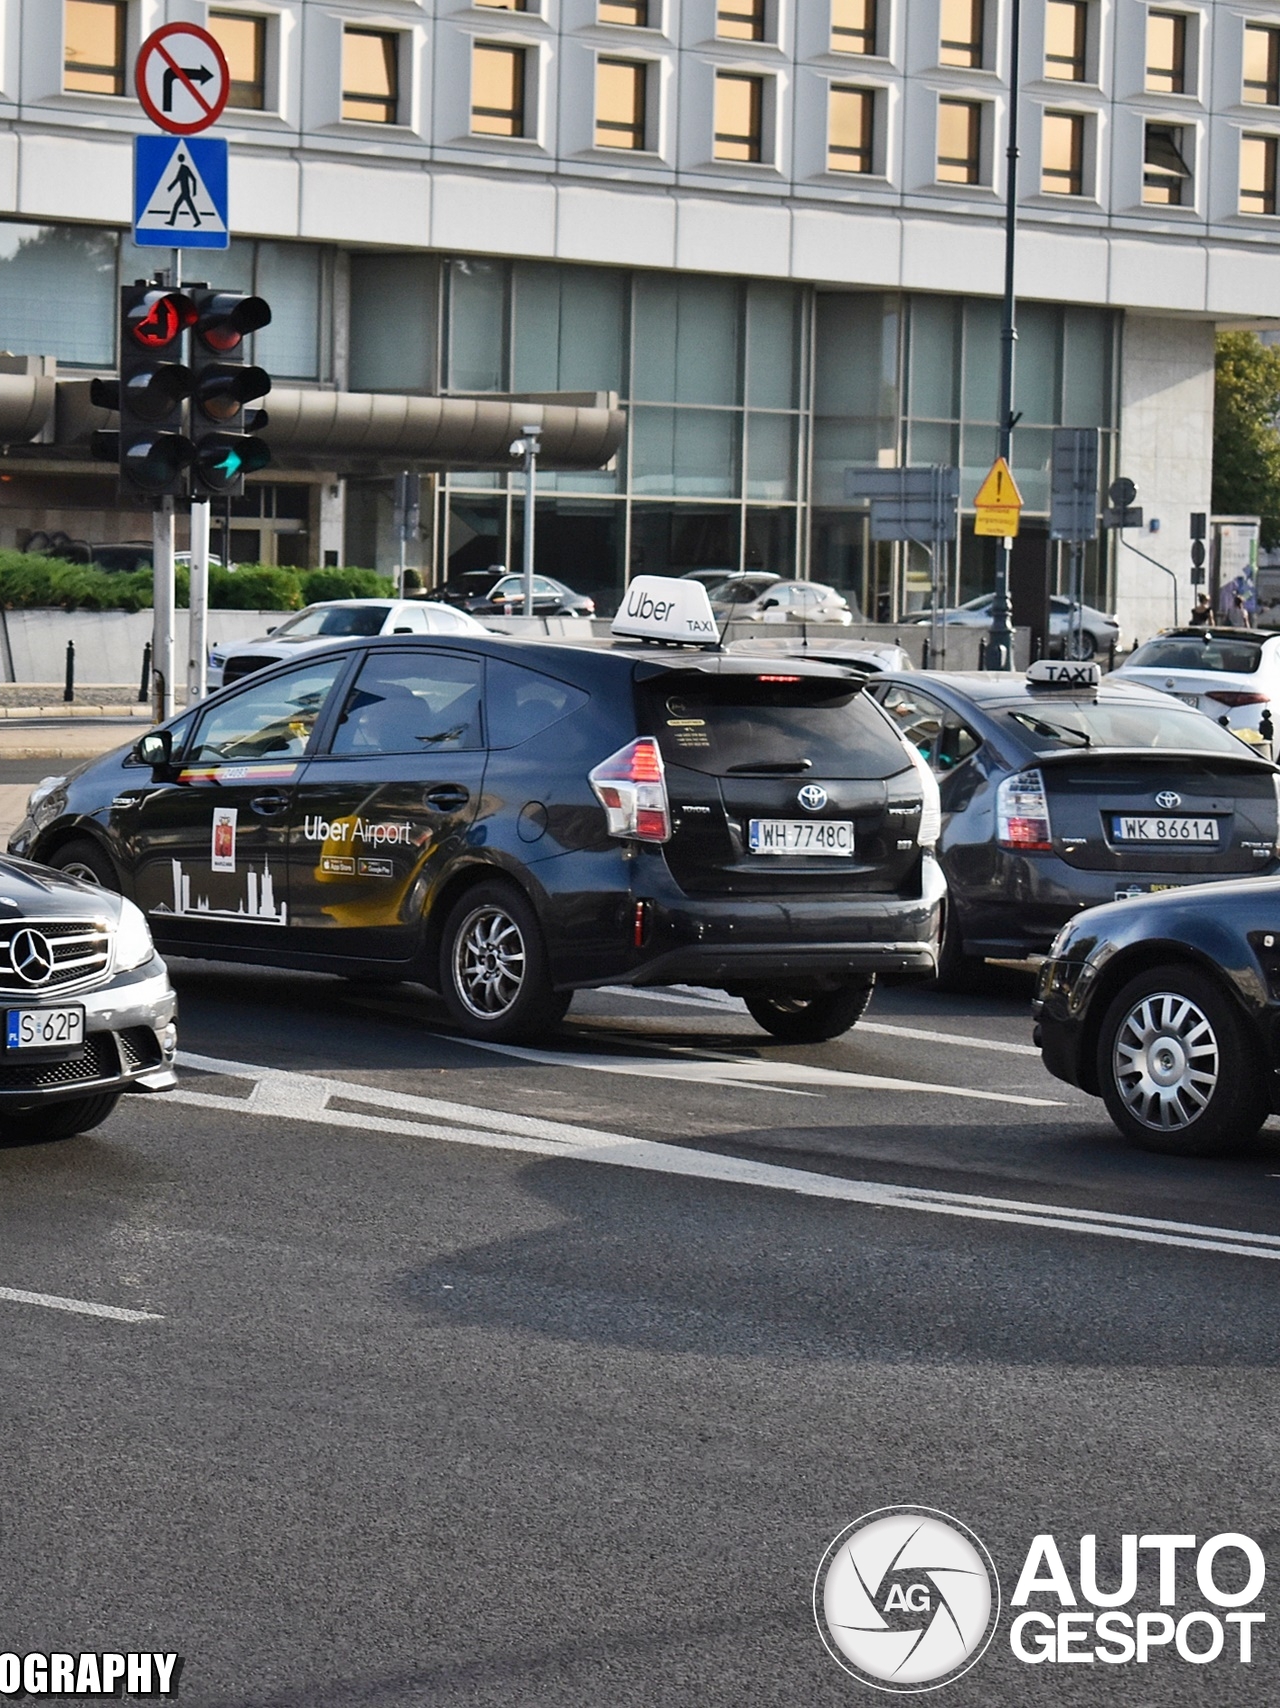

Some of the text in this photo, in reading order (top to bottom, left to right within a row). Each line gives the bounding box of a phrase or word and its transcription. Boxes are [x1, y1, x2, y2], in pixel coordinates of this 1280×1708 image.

[627, 590, 675, 622] Uber
[686, 620, 714, 632] TAXI
[1045, 666, 1093, 683] TAXI
[304, 815, 412, 849] Uber Airport
[762, 825, 847, 848] WH 7748C
[1125, 820, 1214, 840] WK 86614
[21, 1012, 80, 1043] S 62P
